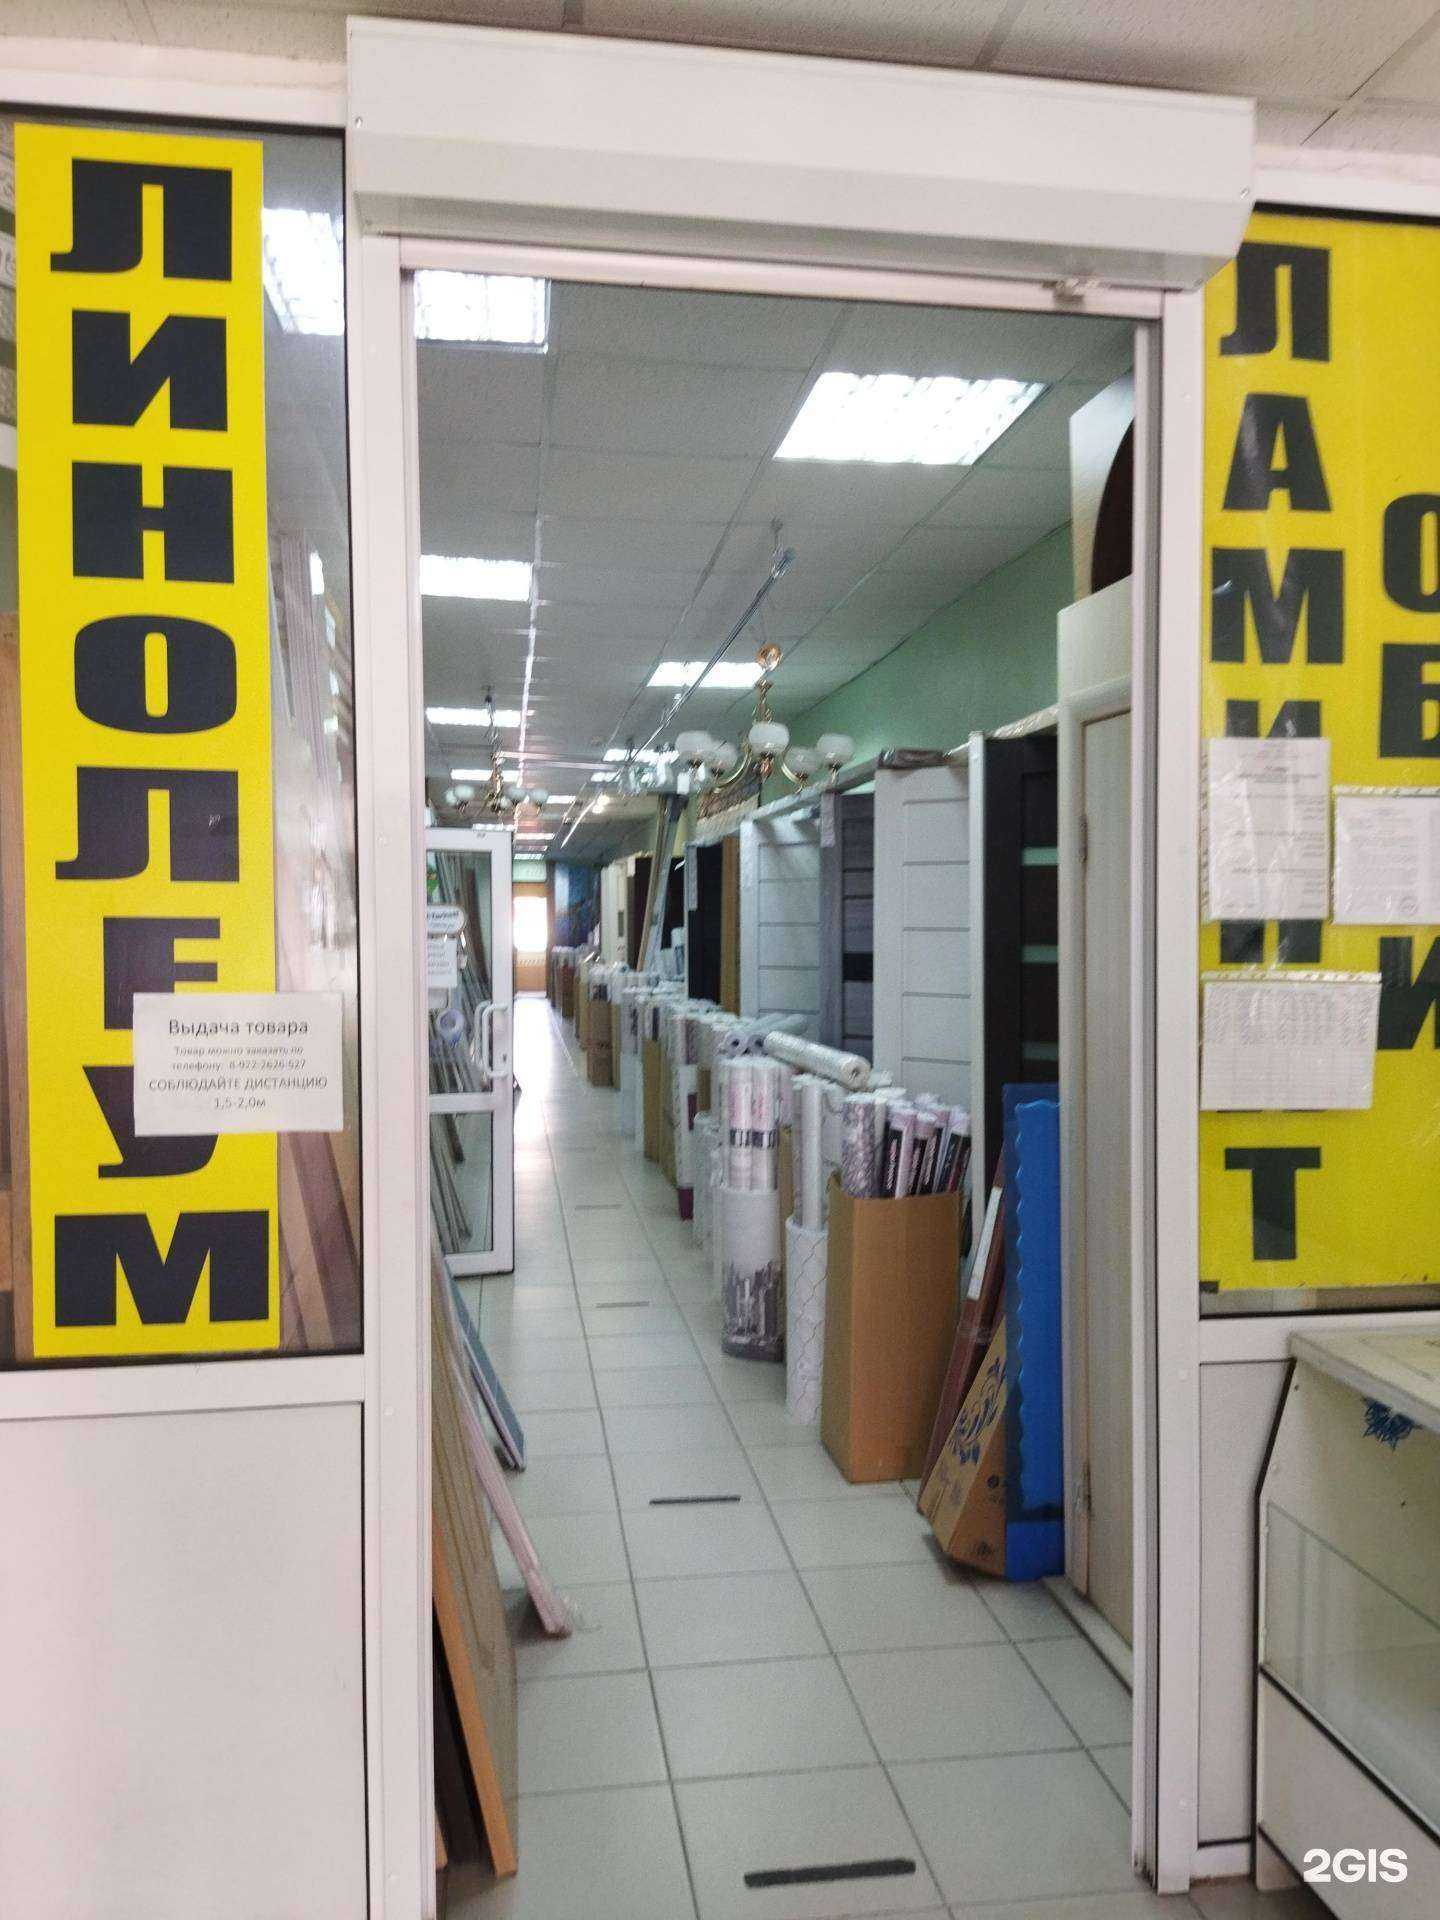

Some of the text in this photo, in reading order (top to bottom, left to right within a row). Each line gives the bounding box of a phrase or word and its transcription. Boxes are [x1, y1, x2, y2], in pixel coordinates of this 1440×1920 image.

[1211, 241, 1345, 1260] ЛАМТ
[1378, 493, 1440, 1050] ОБИ
[169, 1019, 308, 1037] Выдача товара
[174, 1046, 205, 1057] Товар
[207, 1047, 243, 1056] можно
[291, 1046, 304, 1055] по
[149, 1076, 328, 1092] СОБЛЮДАЙТЕ ДИСТАНЦИЮ
